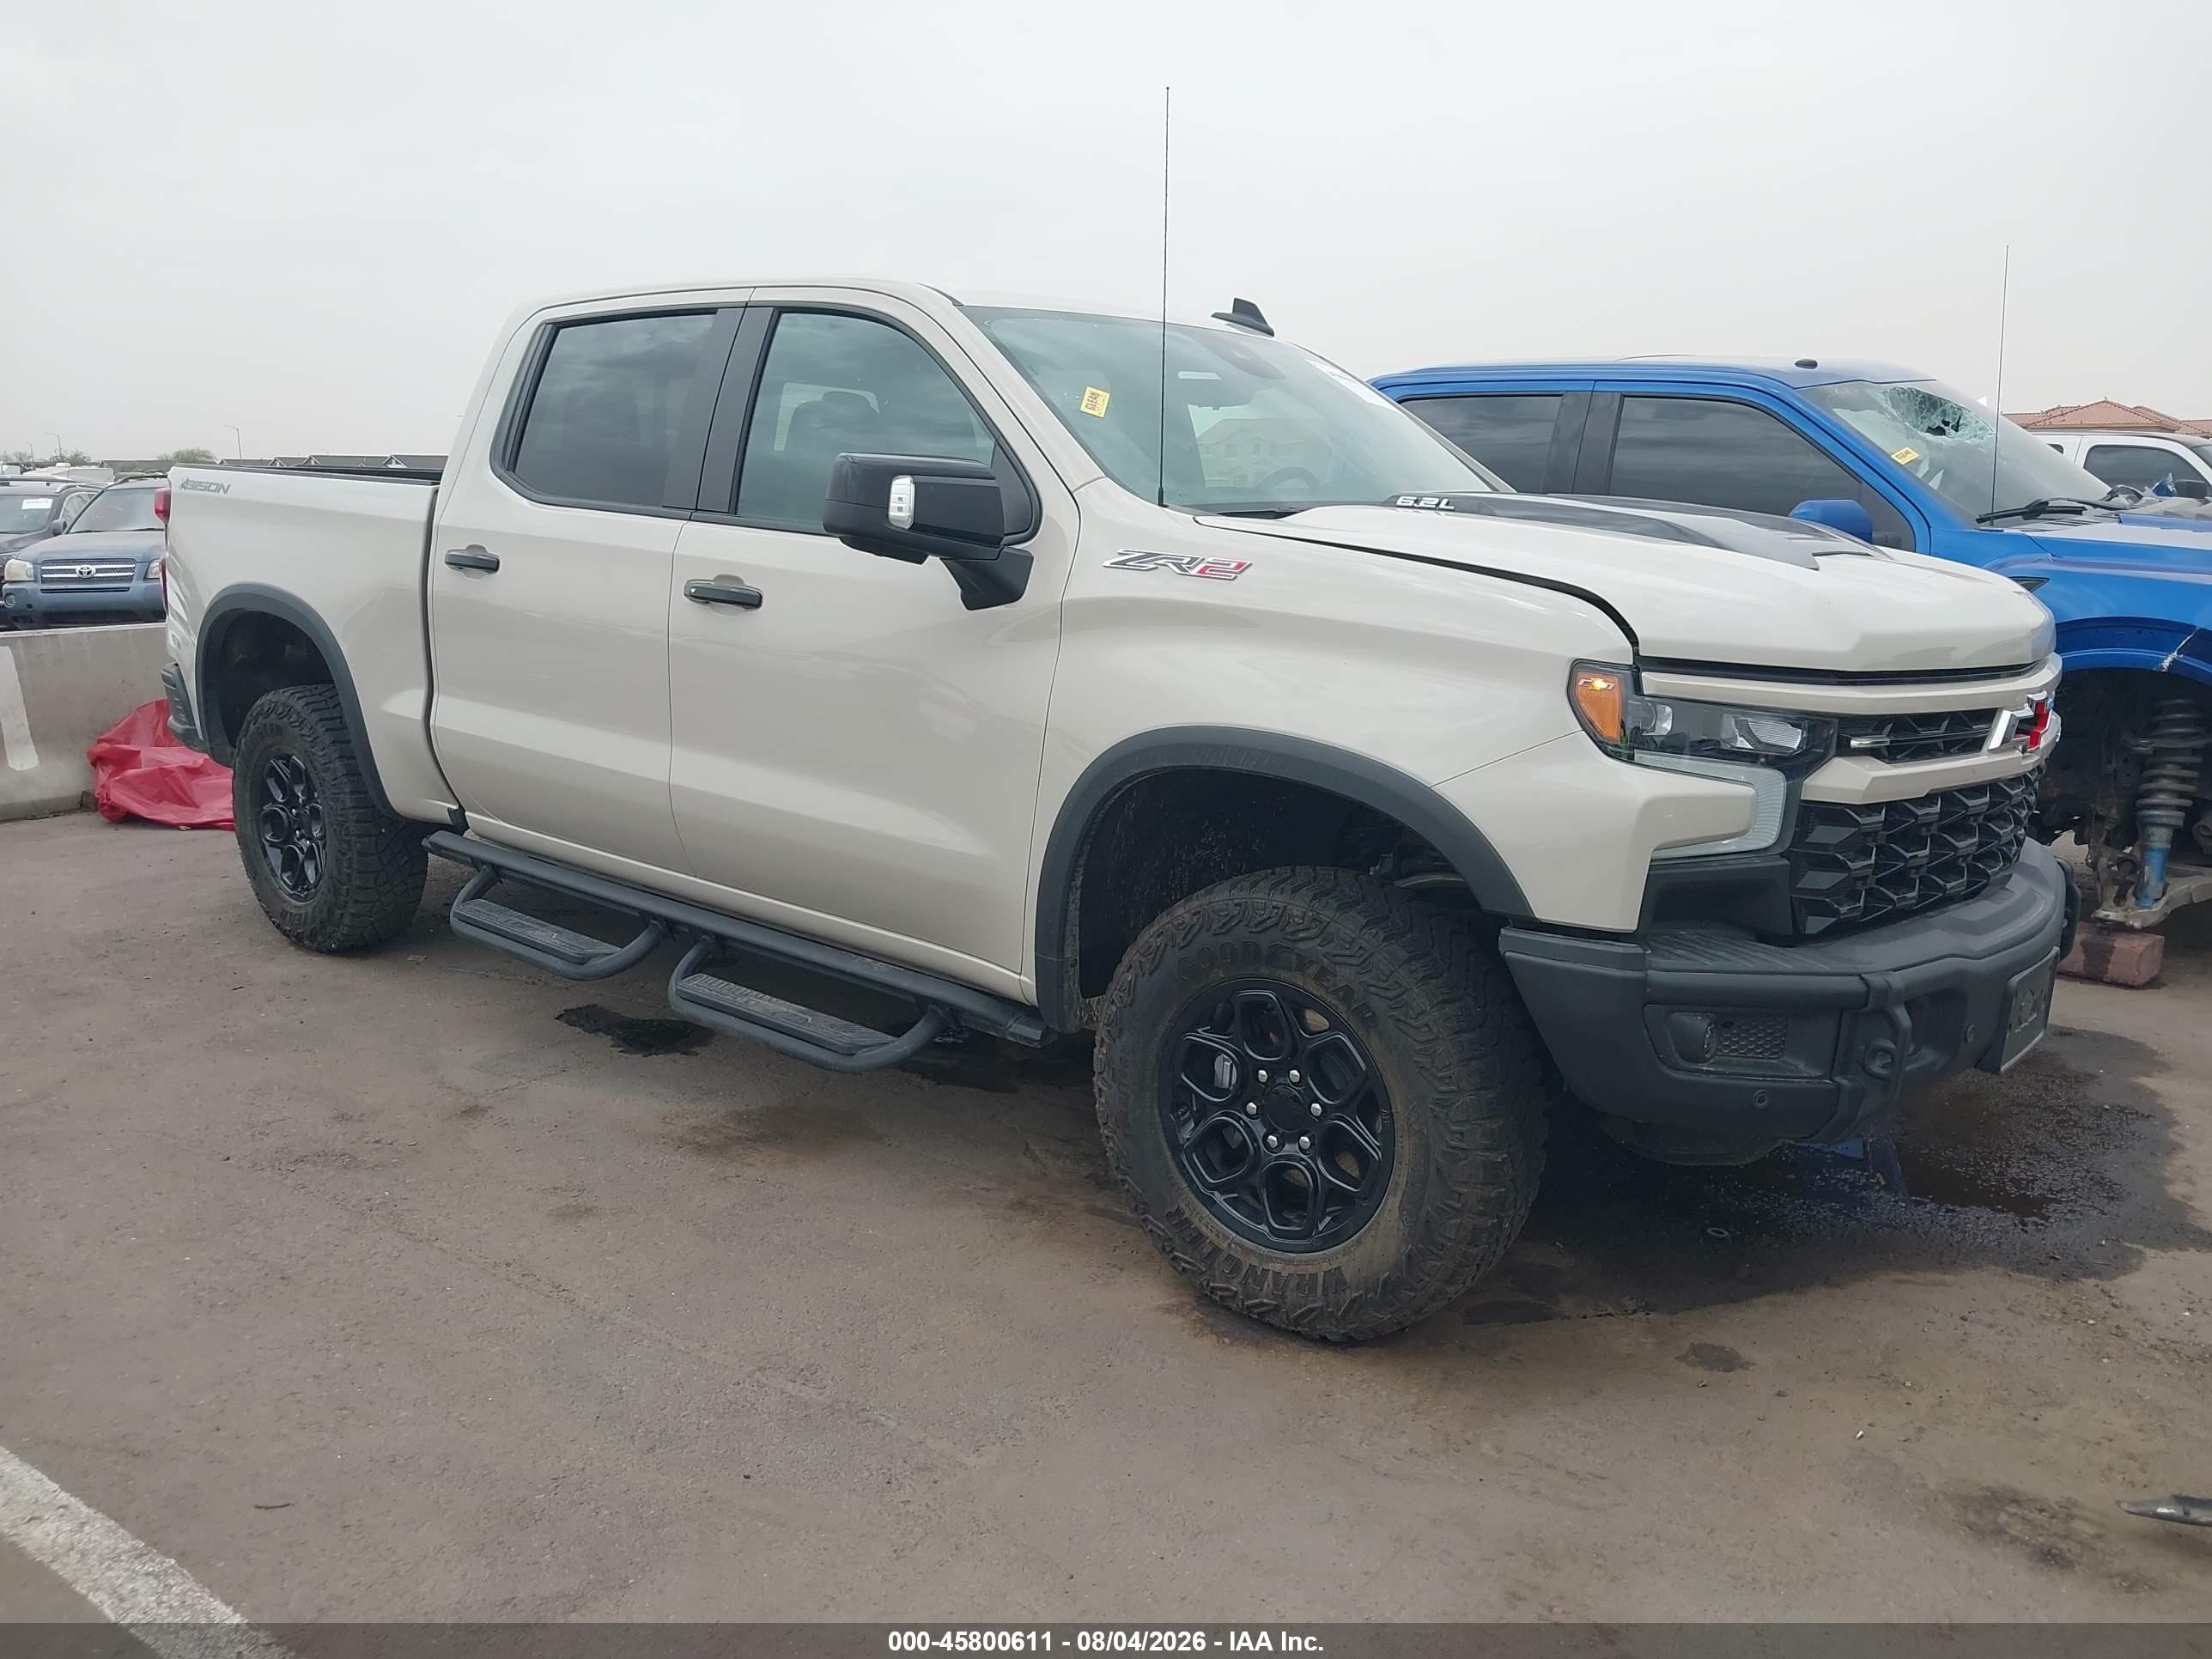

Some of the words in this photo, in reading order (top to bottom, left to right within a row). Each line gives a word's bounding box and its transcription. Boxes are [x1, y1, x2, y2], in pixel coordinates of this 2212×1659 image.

[185, 479, 231, 495] BISON
[1396, 495, 1455, 510] 6.2L
[1103, 549, 1253, 581] ZR2
